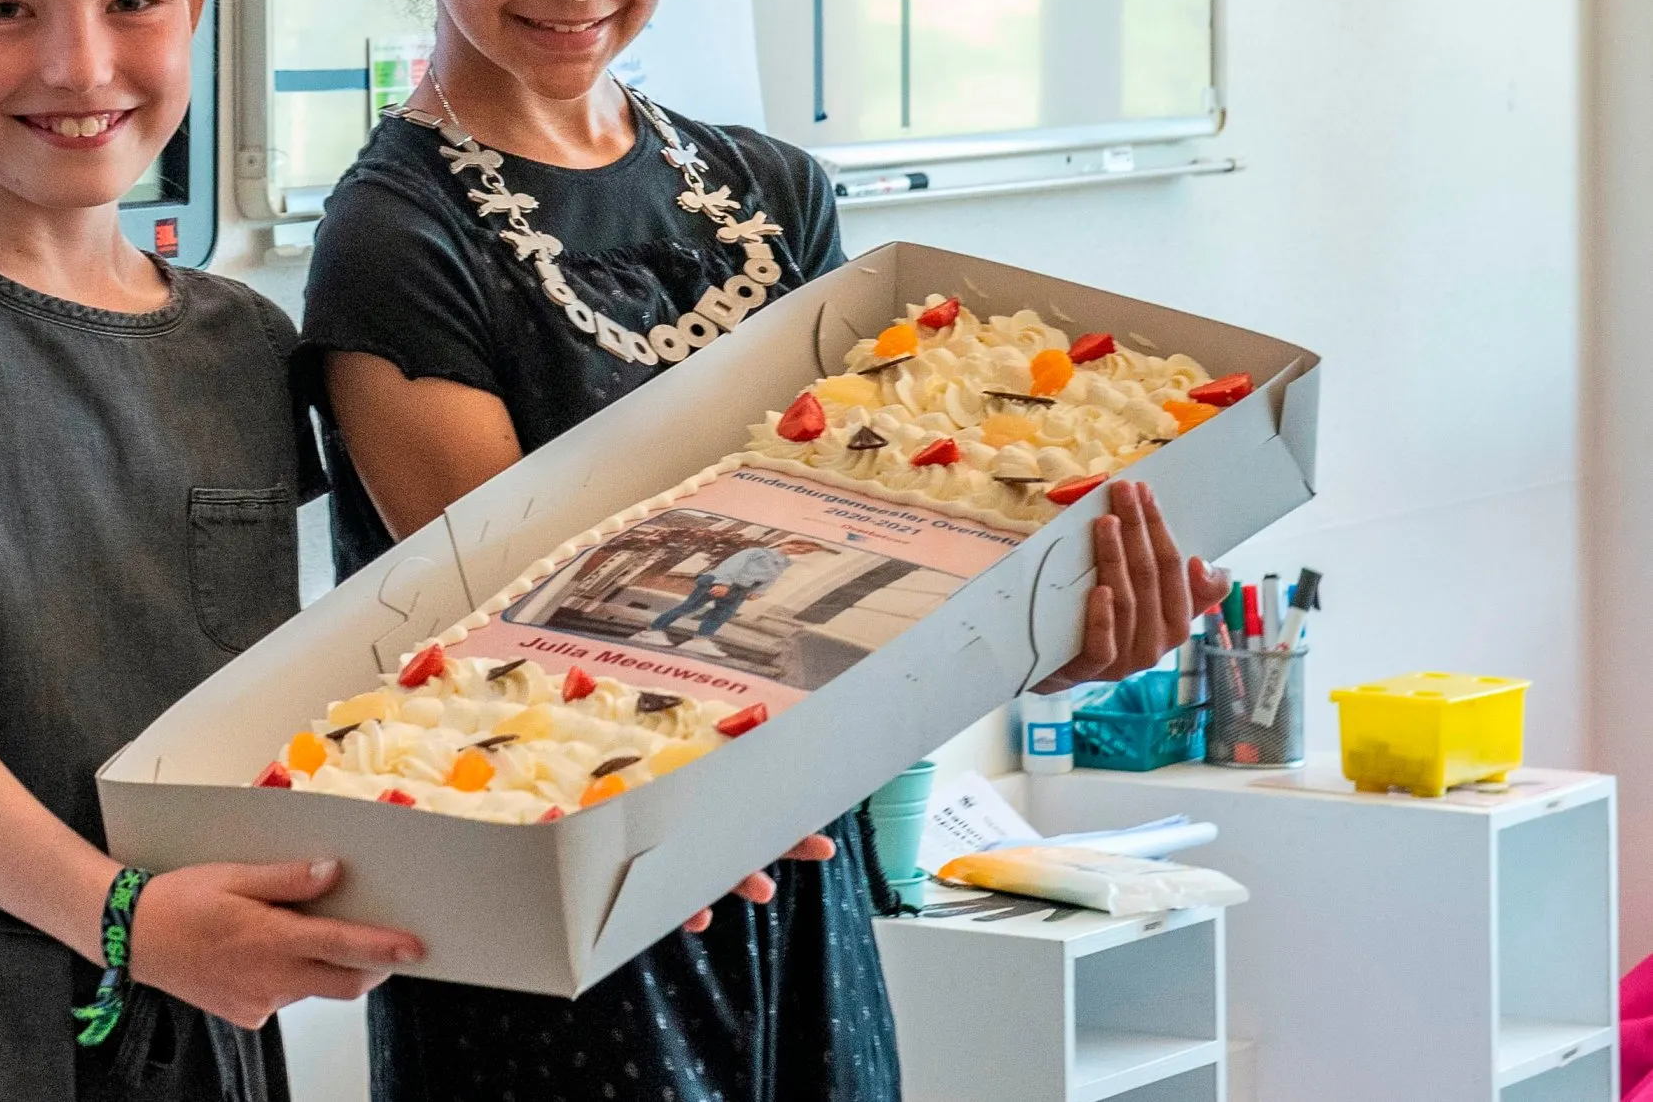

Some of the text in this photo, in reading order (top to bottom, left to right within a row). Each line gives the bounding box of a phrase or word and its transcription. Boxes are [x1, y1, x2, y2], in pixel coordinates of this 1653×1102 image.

[732, 471, 928, 524] Kinderburgemeester
[823, 506, 922, 536] 2020-2021
[519, 636, 749, 694] Julia Meeuwsen
